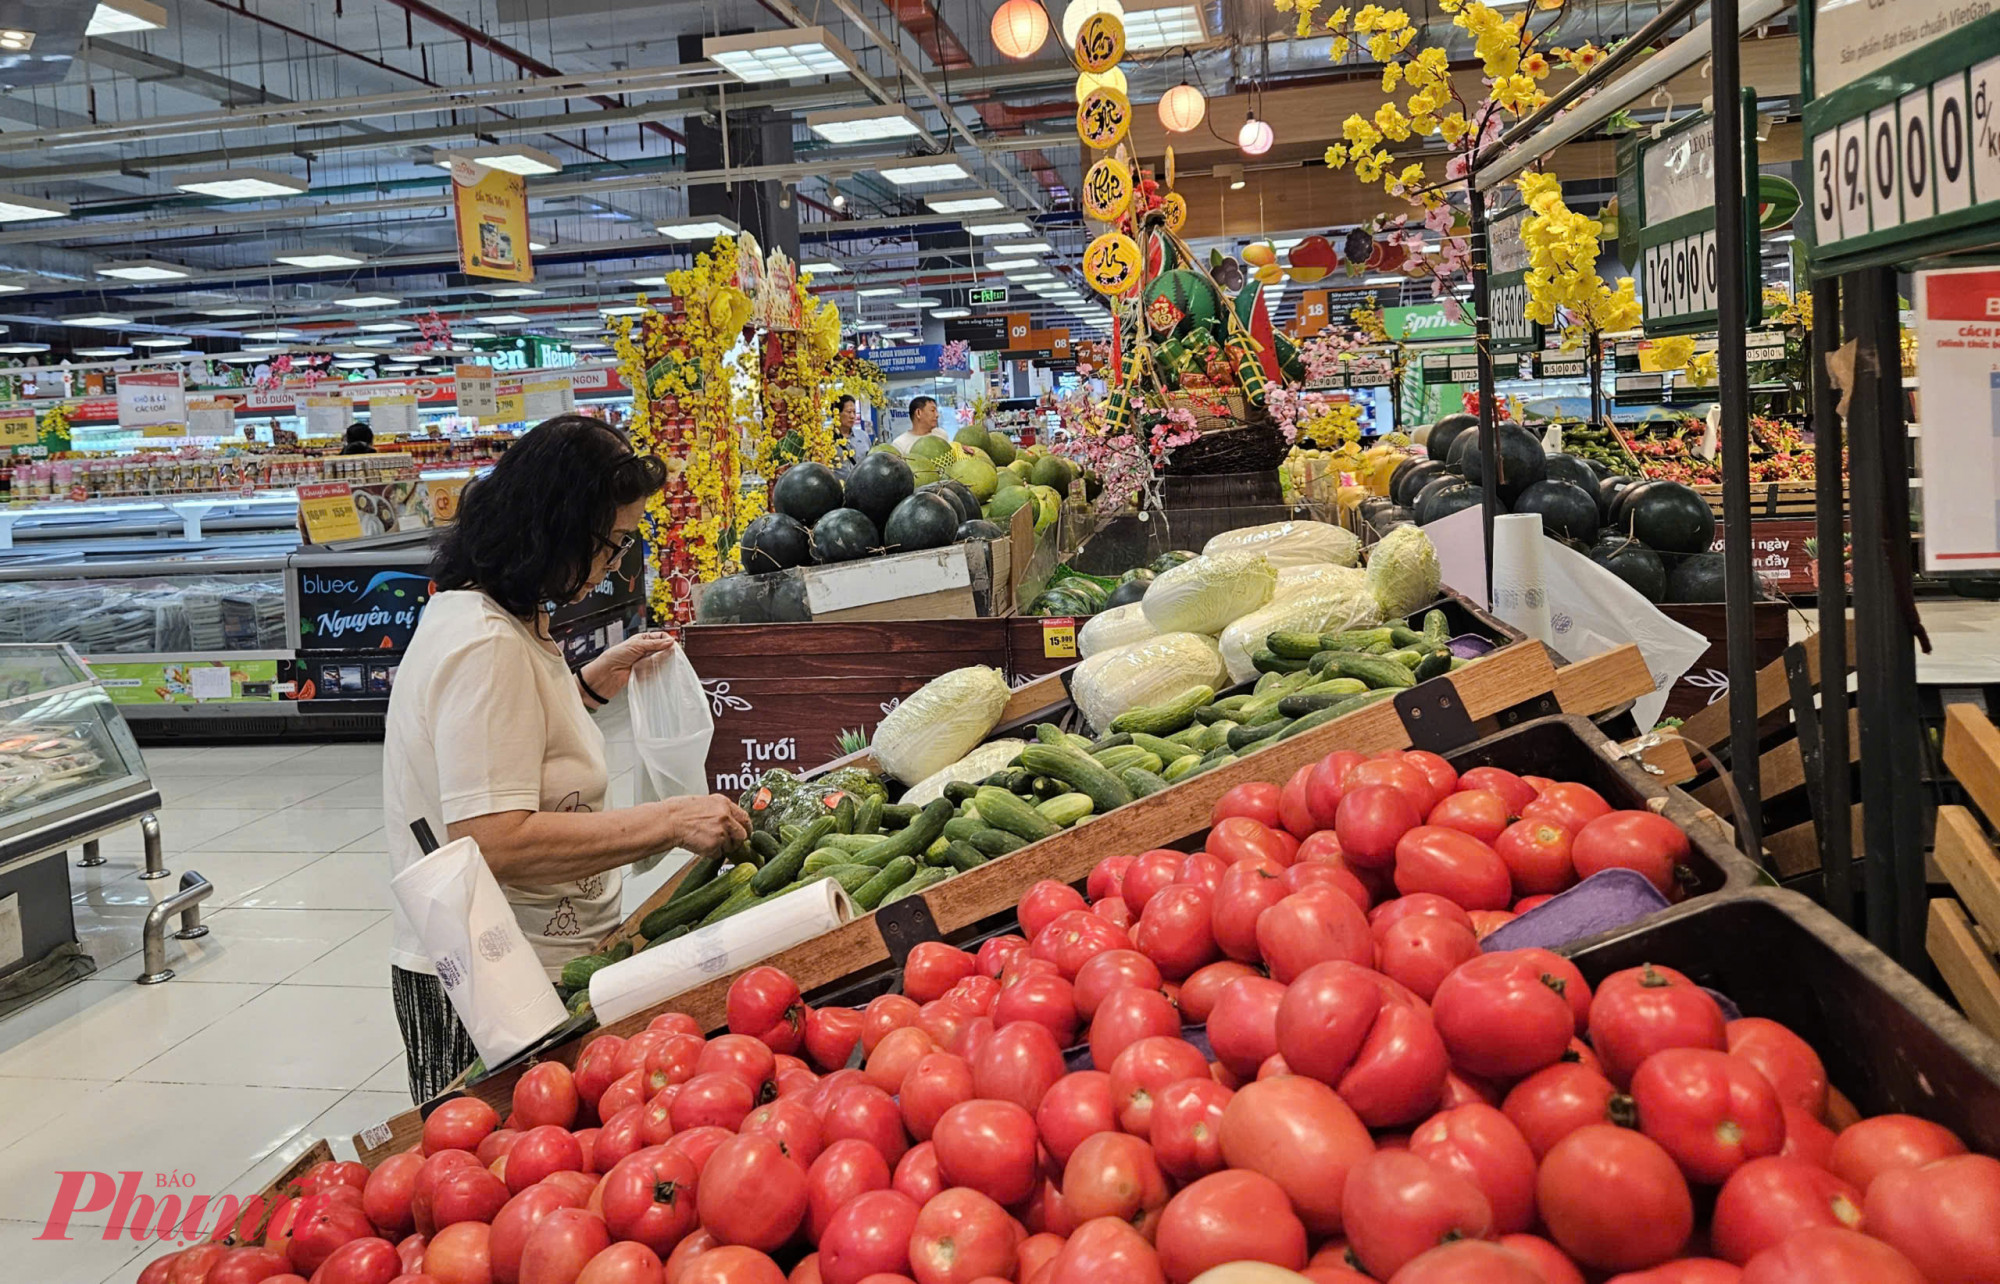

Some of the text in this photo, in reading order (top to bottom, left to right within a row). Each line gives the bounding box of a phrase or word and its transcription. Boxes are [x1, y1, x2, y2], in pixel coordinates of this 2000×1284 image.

[1820, 79, 2000, 221] 39.000 đ/k
[1649, 243, 1717, 304] 19.900
[993, 291, 1004, 299] EXIT
[1307, 304, 1324, 316] 18
[1986, 297, 2000, 316] B
[1012, 326, 1027, 337] 09
[1958, 324, 1992, 337] CÁCH
[1054, 339, 1067, 348] 08
[572, 374, 600, 385] NGON
[1758, 537, 1790, 551] ngày
[1765, 554, 1789, 568] đầy
[317, 604, 415, 638] Nguyên vị
[716, 761, 761, 790] mỗi
